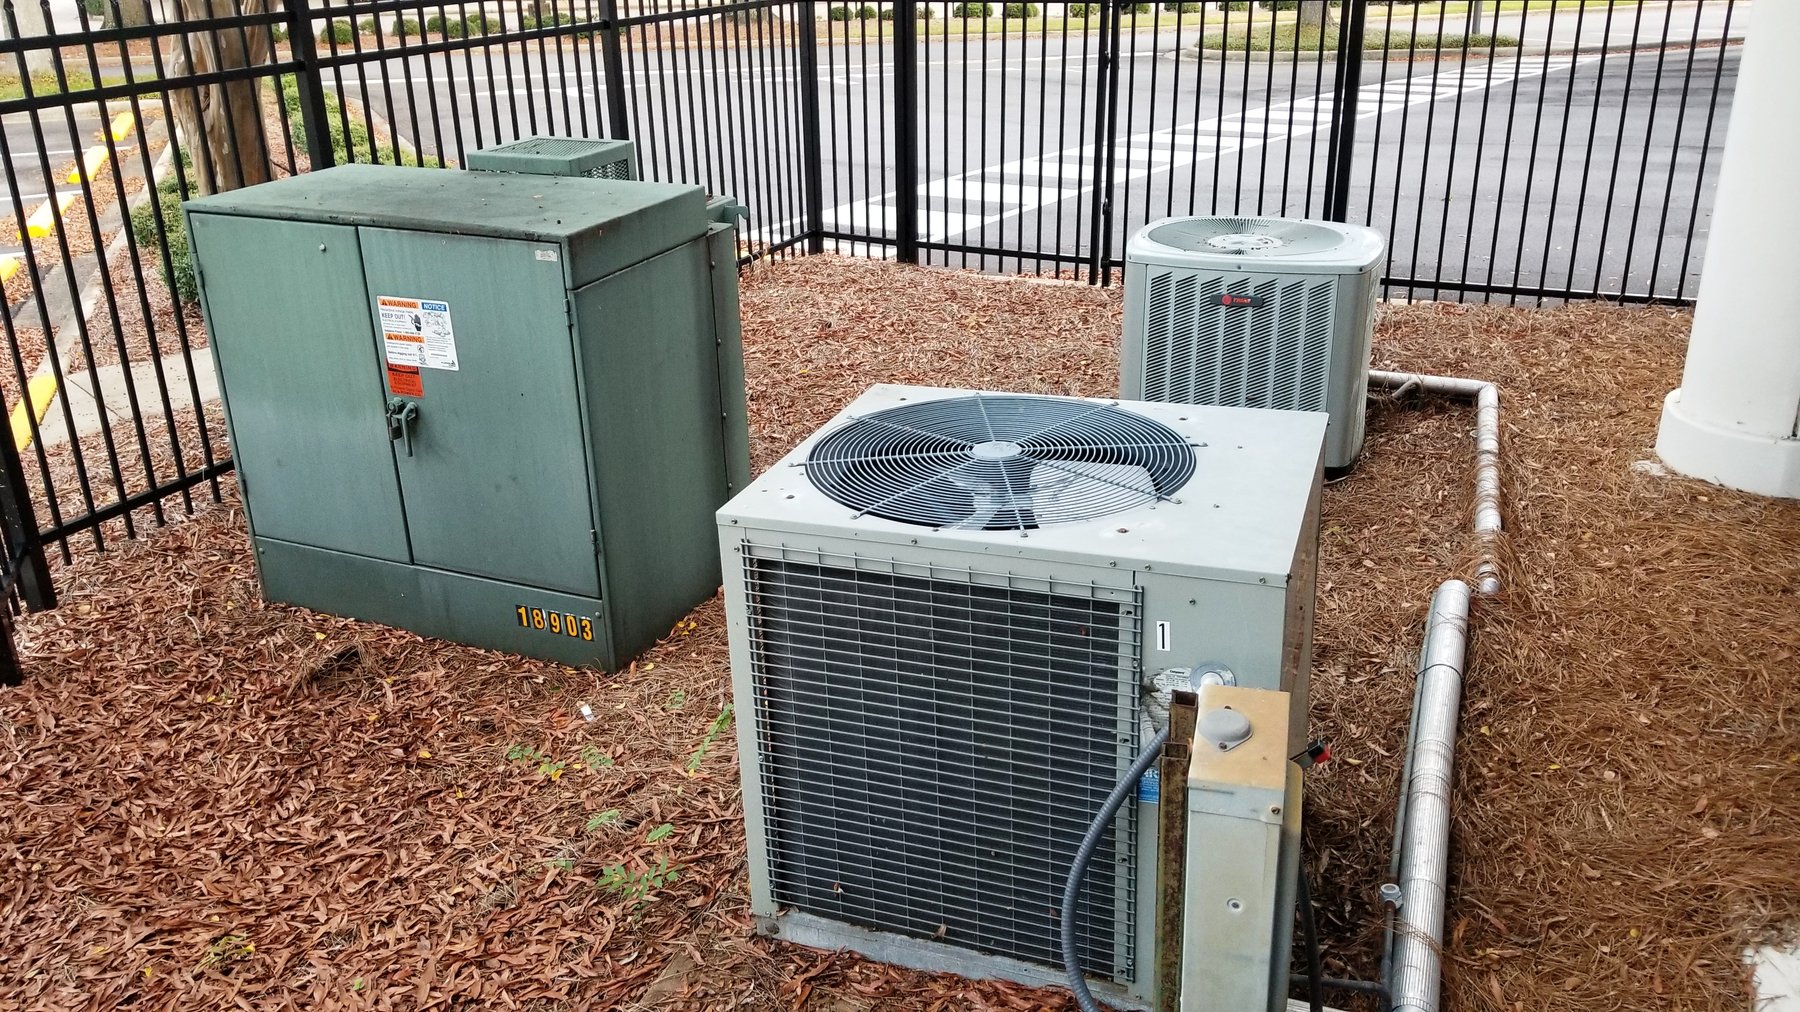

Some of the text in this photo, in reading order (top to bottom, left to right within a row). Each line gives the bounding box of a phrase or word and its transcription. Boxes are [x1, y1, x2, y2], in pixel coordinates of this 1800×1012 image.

[387, 299, 417, 309] WARNING
[423, 303, 446, 311] NOTICE
[392, 333, 422, 343] WARNING
[517, 606, 593, 641] 18903
[1158, 622, 1165, 650] 1
